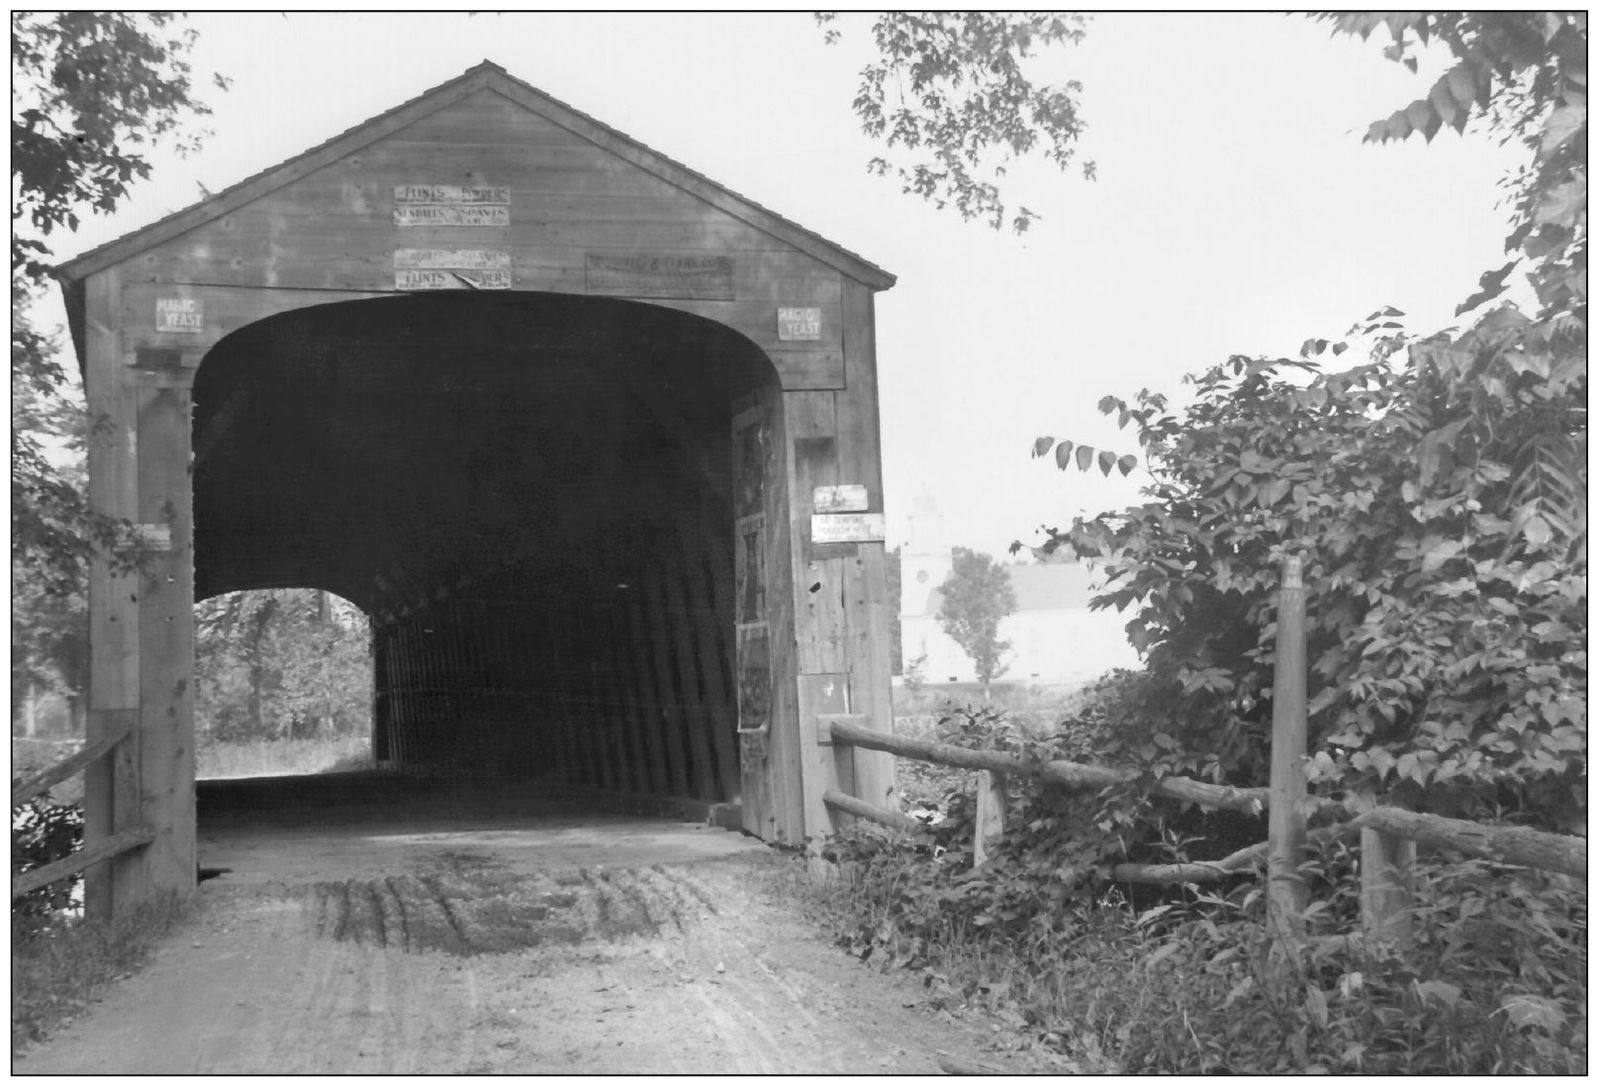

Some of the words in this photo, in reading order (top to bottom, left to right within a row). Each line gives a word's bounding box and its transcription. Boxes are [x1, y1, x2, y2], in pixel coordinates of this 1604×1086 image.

[156, 299, 195, 313] MAGIC
[166, 312, 203, 326] YEAST
[786, 322, 821, 335] YEAST
